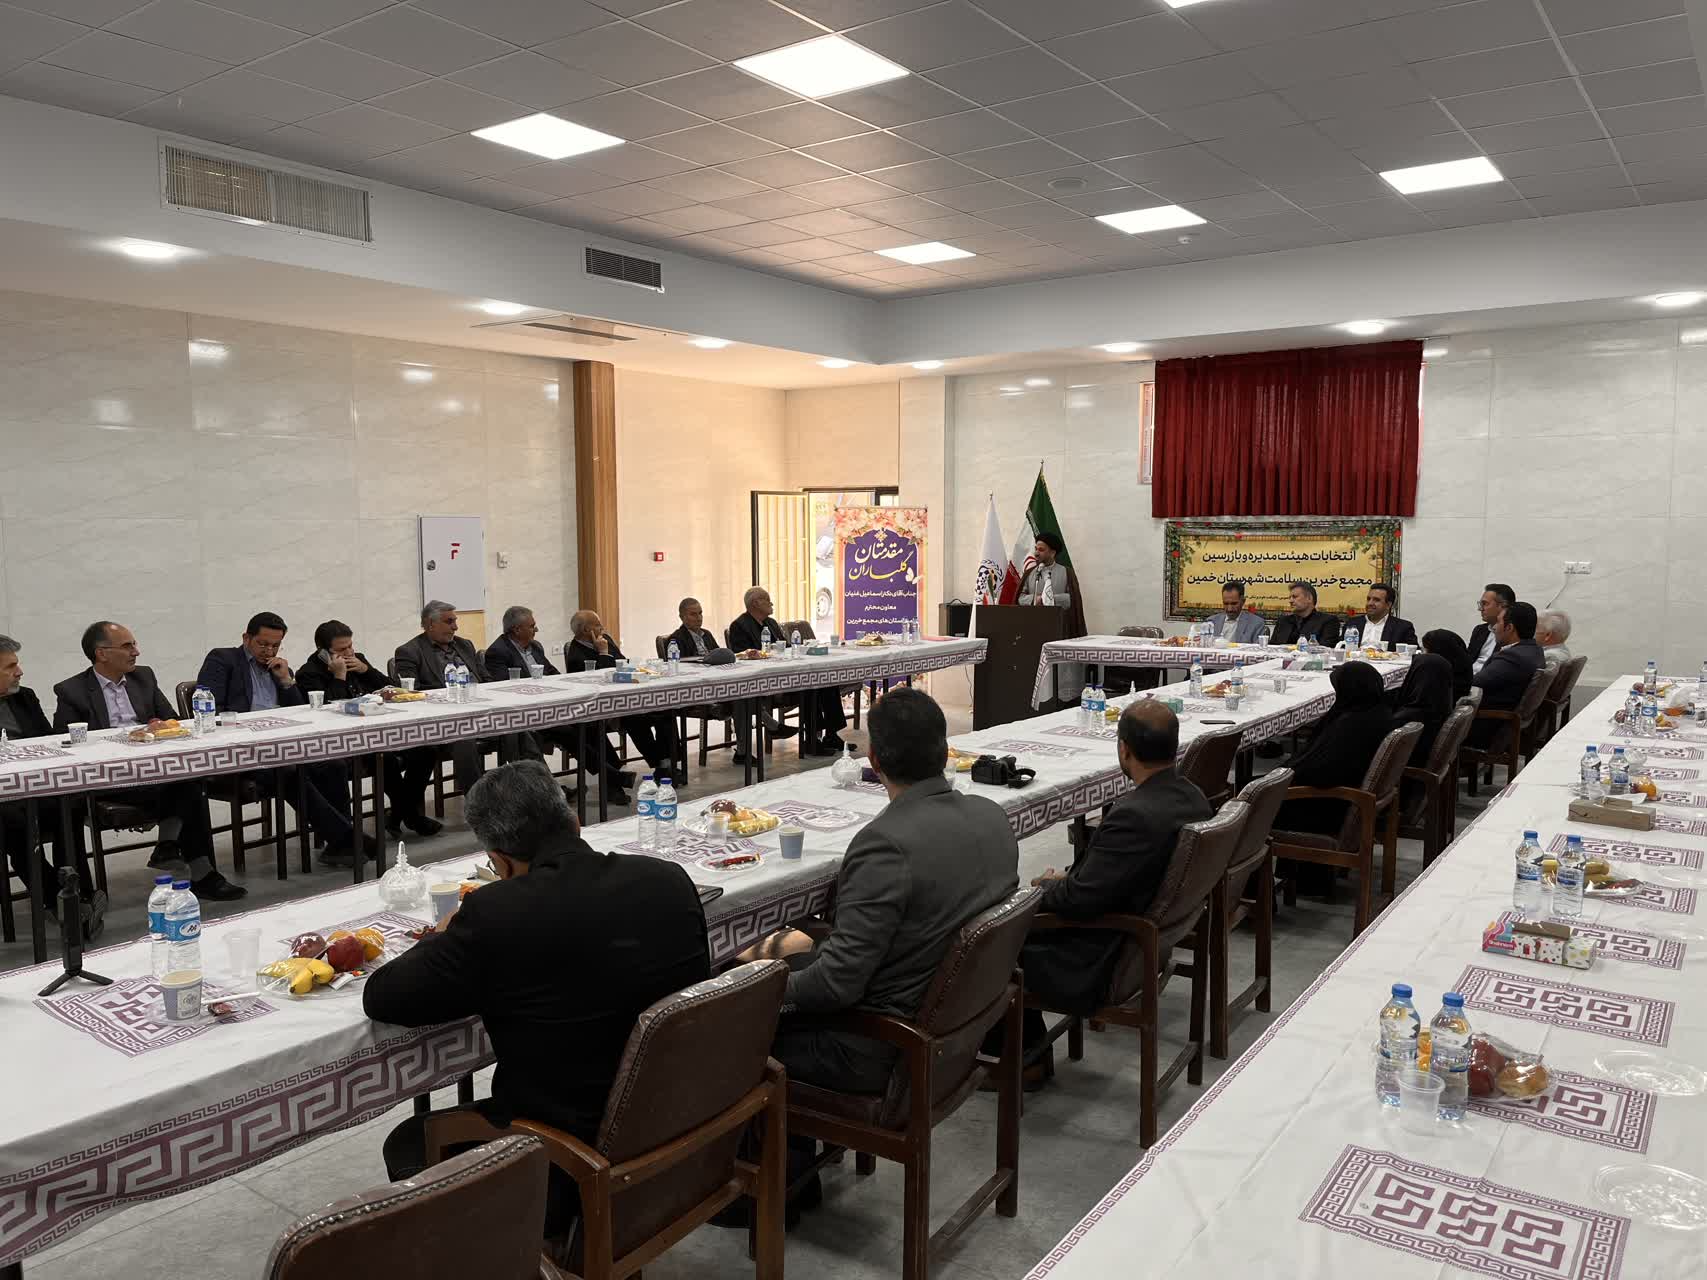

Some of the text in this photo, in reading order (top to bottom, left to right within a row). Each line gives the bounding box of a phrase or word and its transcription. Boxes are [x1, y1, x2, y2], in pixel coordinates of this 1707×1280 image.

[1202, 549, 1242, 563] بازرسین
[1249, 551, 1277, 563] مدیره
[1278, 550, 1309, 564] هیئت
[1310, 550, 1356, 564] انتخابات
[1187, 572, 1217, 584] خمین
[1338, 576, 1373, 589] مجمع
